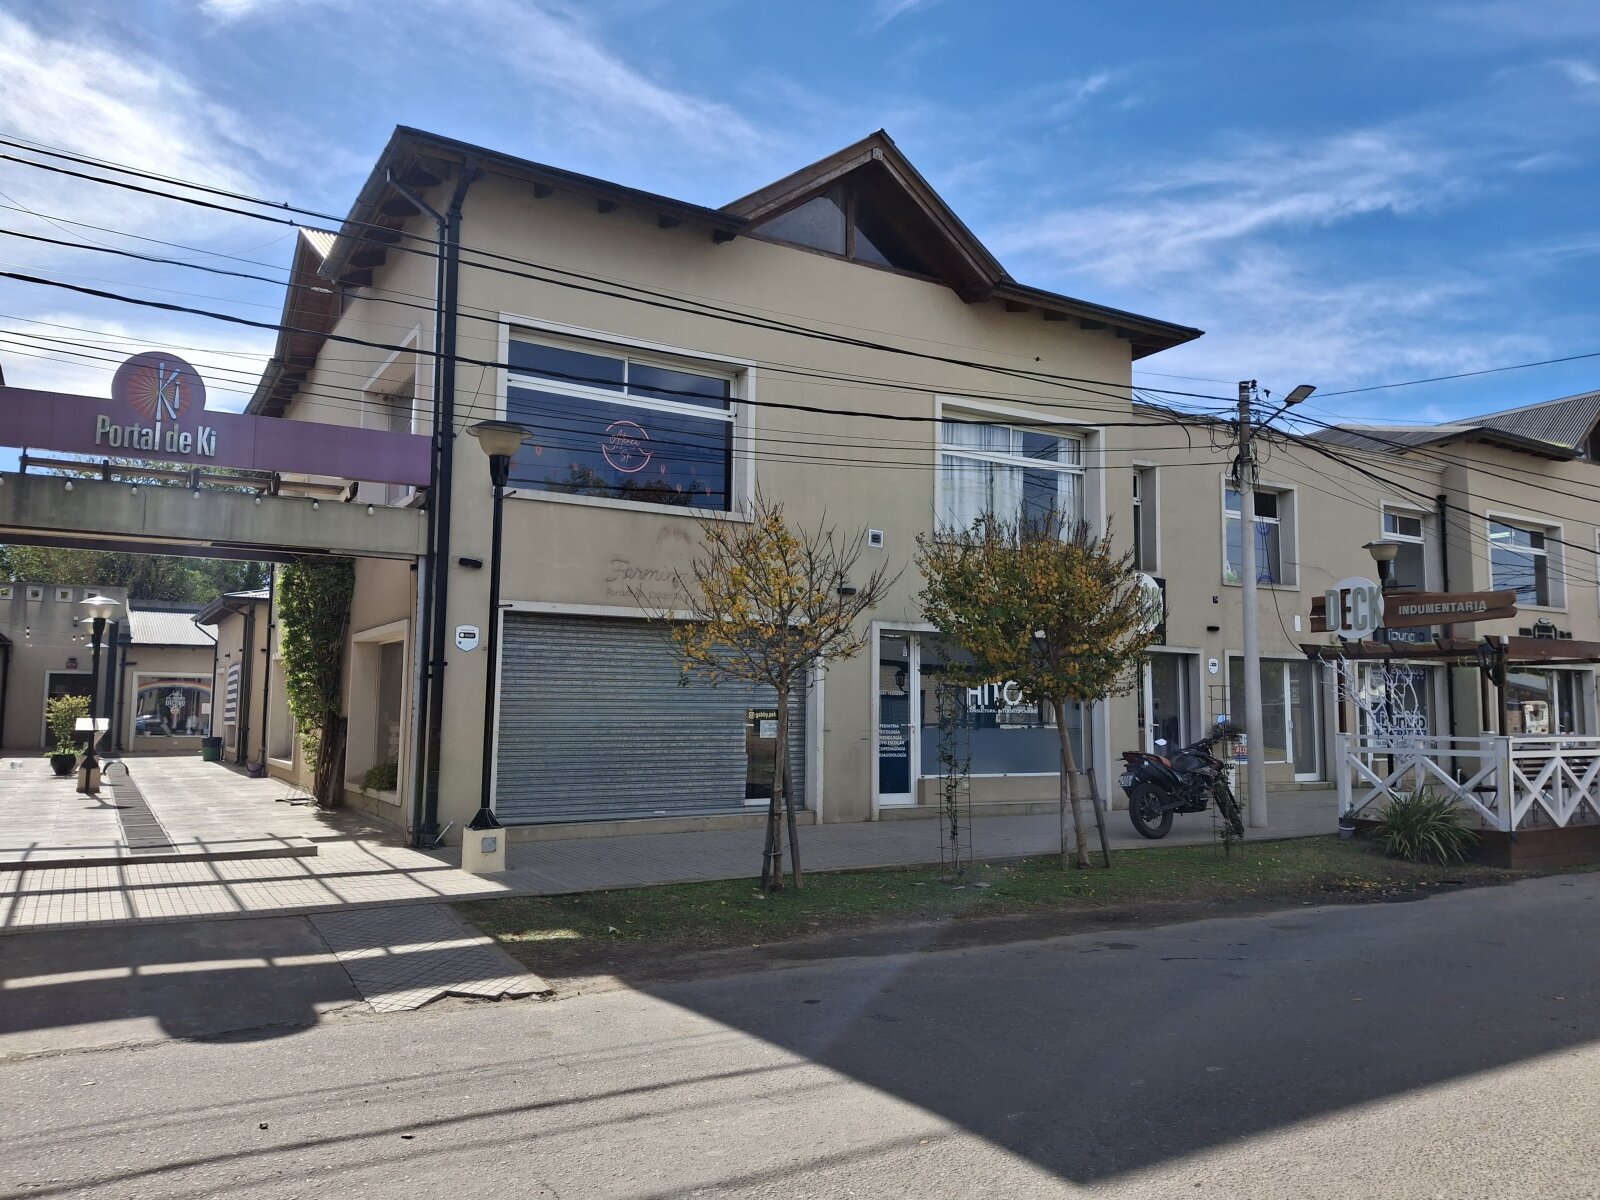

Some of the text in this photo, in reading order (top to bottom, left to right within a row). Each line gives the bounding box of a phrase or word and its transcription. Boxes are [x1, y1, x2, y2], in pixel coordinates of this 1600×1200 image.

[95, 414, 217, 457] Portal de Ki
[1325, 586, 1488, 631] DECK INDUMENTARIA
